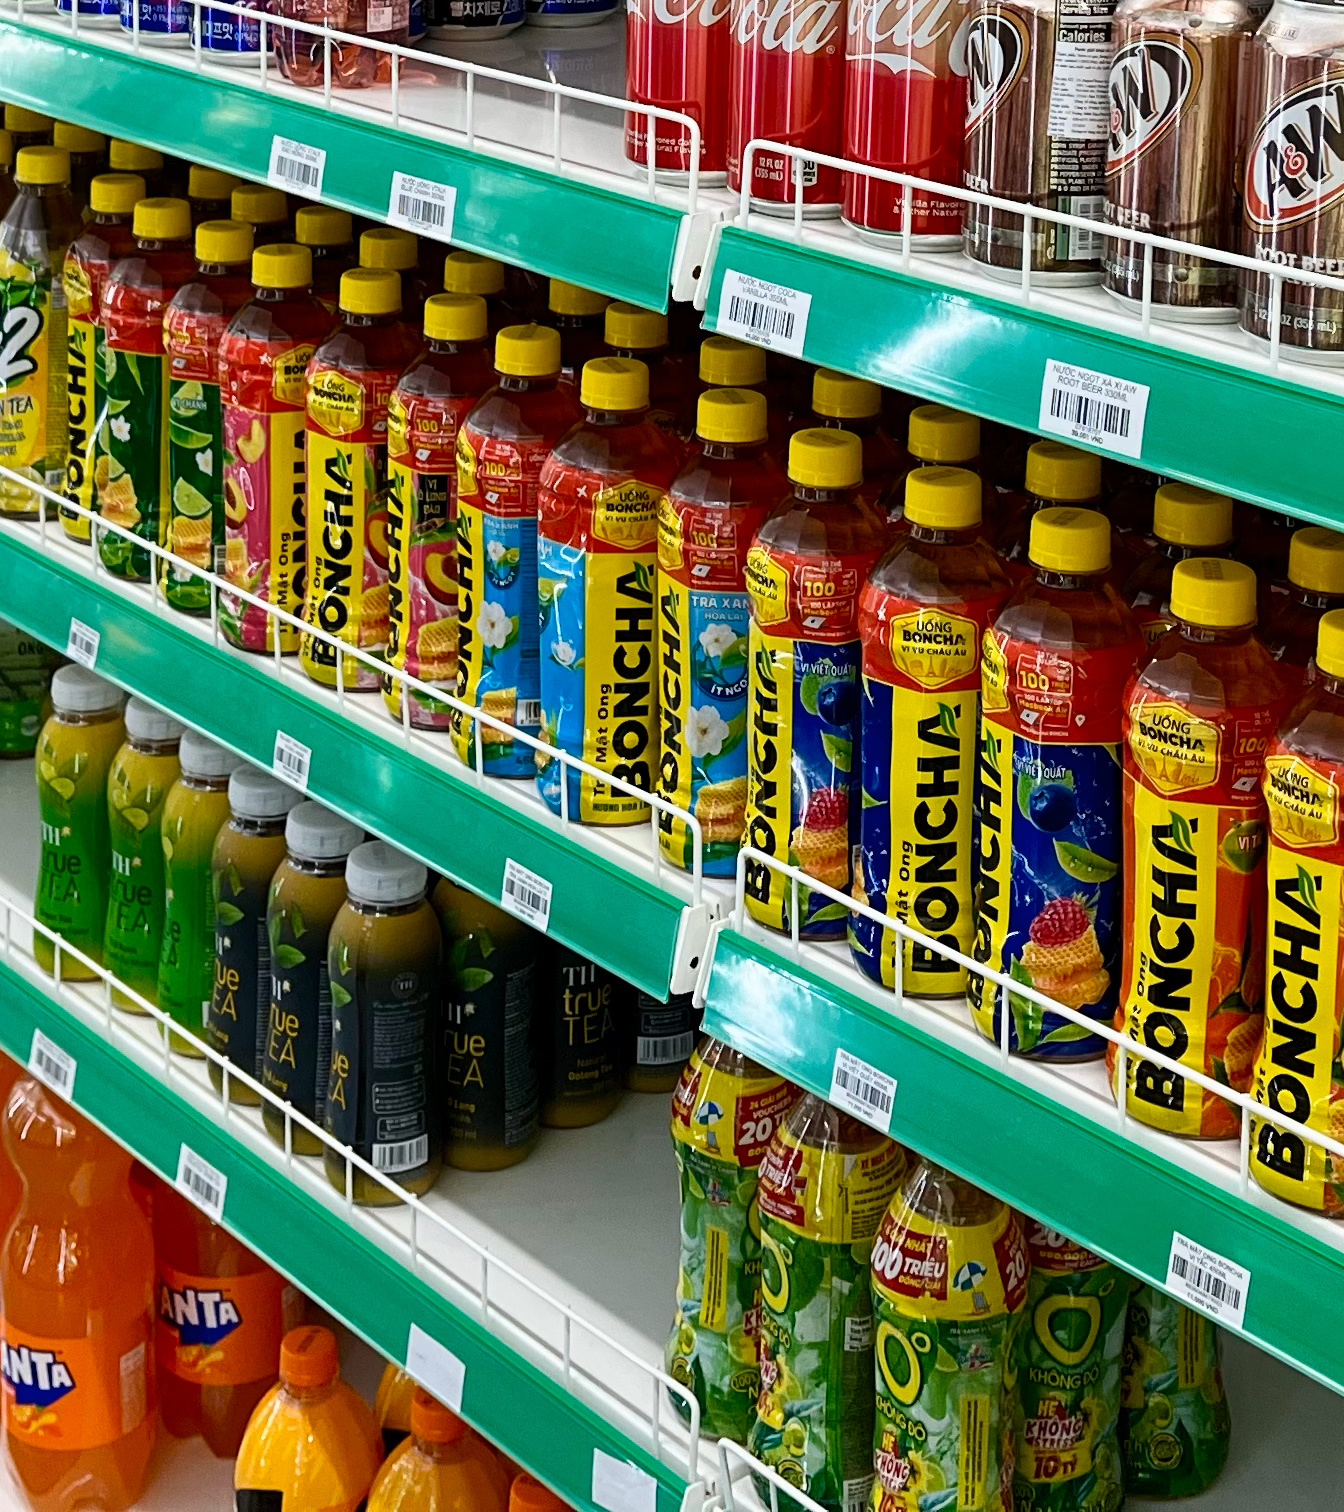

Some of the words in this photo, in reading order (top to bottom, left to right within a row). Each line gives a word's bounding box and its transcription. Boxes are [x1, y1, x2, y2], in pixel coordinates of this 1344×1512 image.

[1058, 27, 1106, 44] Calories
[692, 596, 718, 609] TRÀ
[915, 619, 952, 635] UỐNG
[901, 631, 966, 647] BONCHA
[1020, 669, 1049, 690] 100
[597, 682, 612, 720] Ong
[1152, 712, 1191, 733] UỐNG
[1139, 724, 1206, 752] BONCHA
[1134, 810, 1199, 1111] BONCHA
[562, 987, 612, 1017] true
